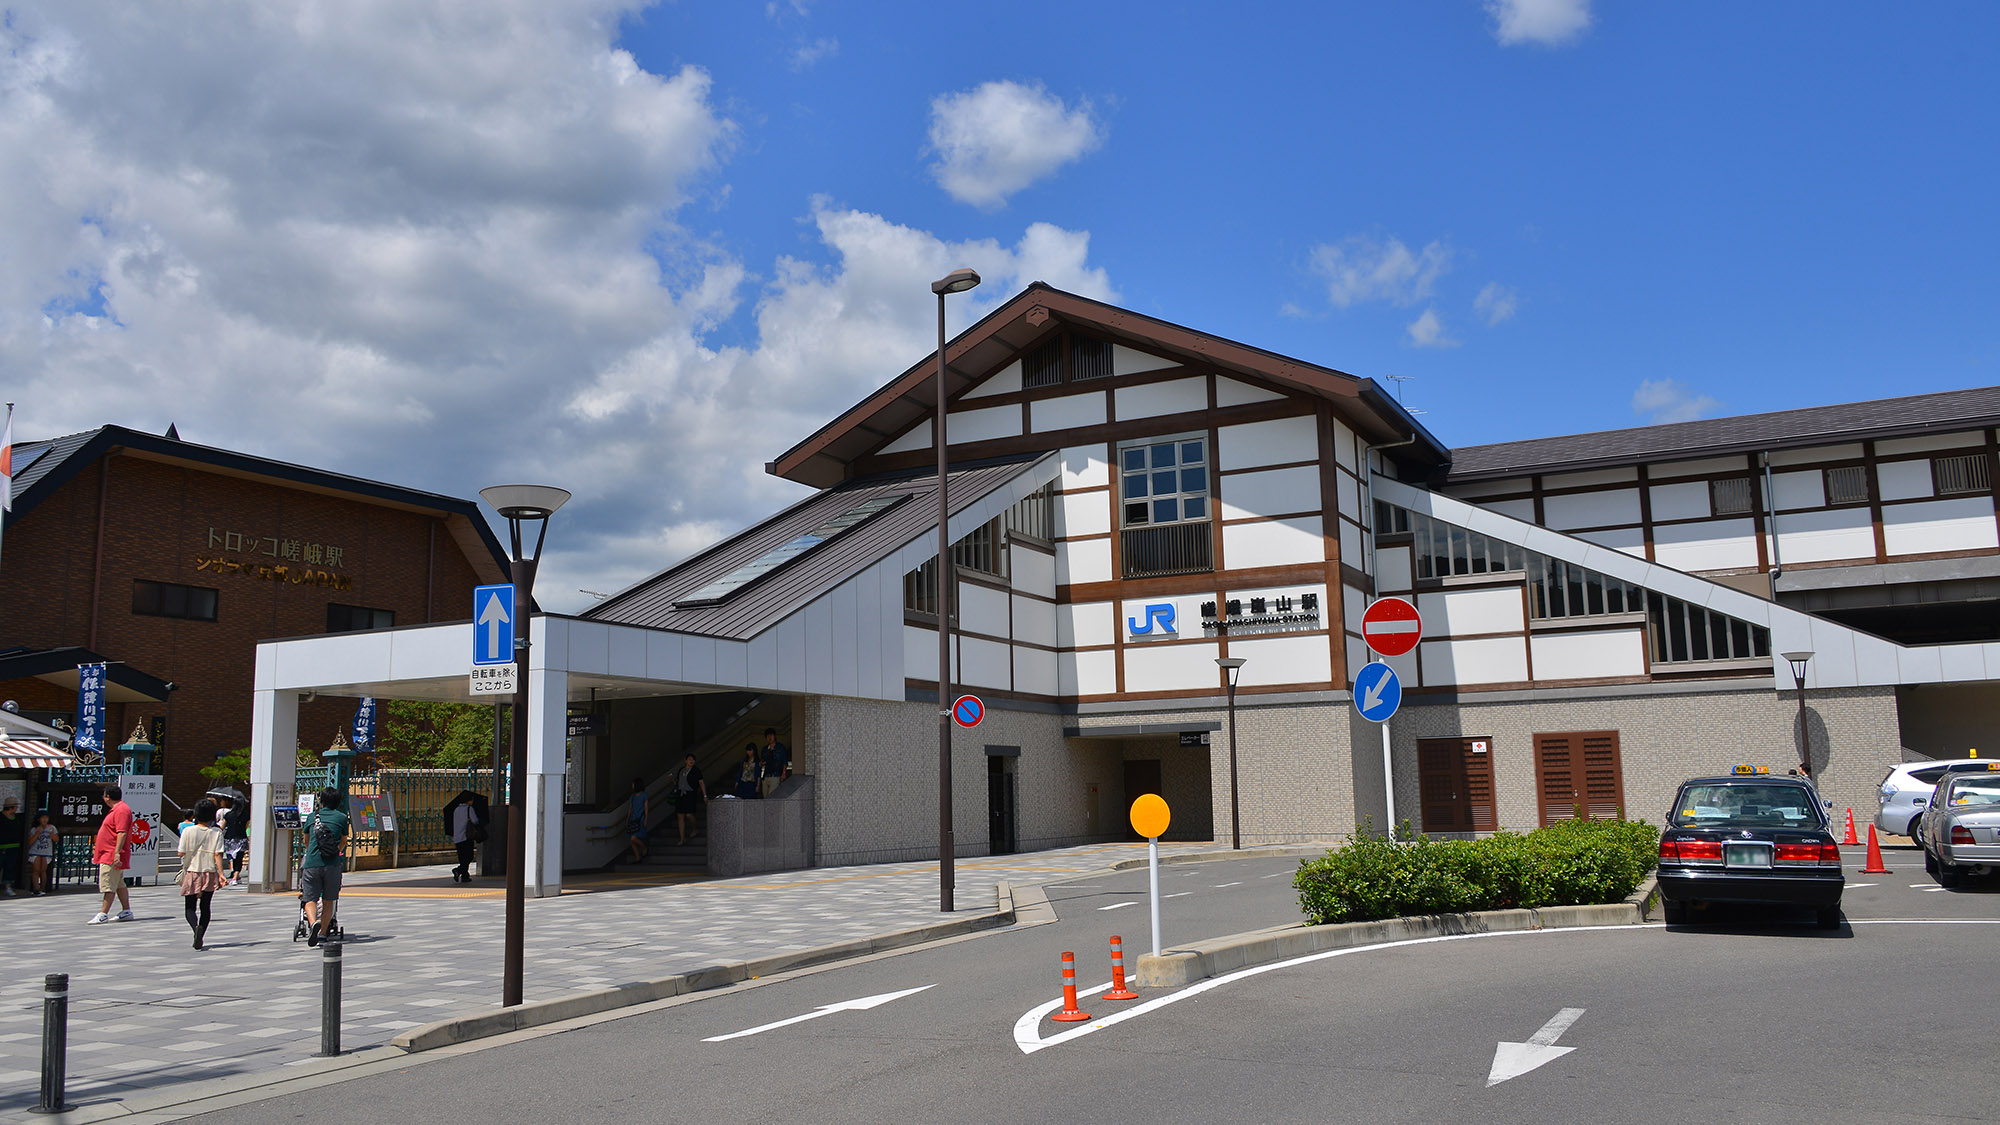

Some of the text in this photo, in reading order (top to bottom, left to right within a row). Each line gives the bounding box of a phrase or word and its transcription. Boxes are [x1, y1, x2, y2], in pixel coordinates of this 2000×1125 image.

[207, 527, 344, 568] トロッコ嵯峨駅
[291, 568, 352, 590] JAPAN
[1128, 603, 1176, 634] JR
[471, 667, 516, 679] 自転車を除く
[475, 680, 512, 691] ここから
[82, 677, 99, 737] 保津川下り
[63, 804, 103, 816] 嵯峨駅
[132, 811, 160, 822] オラマ
[130, 836, 158, 853] APAN
